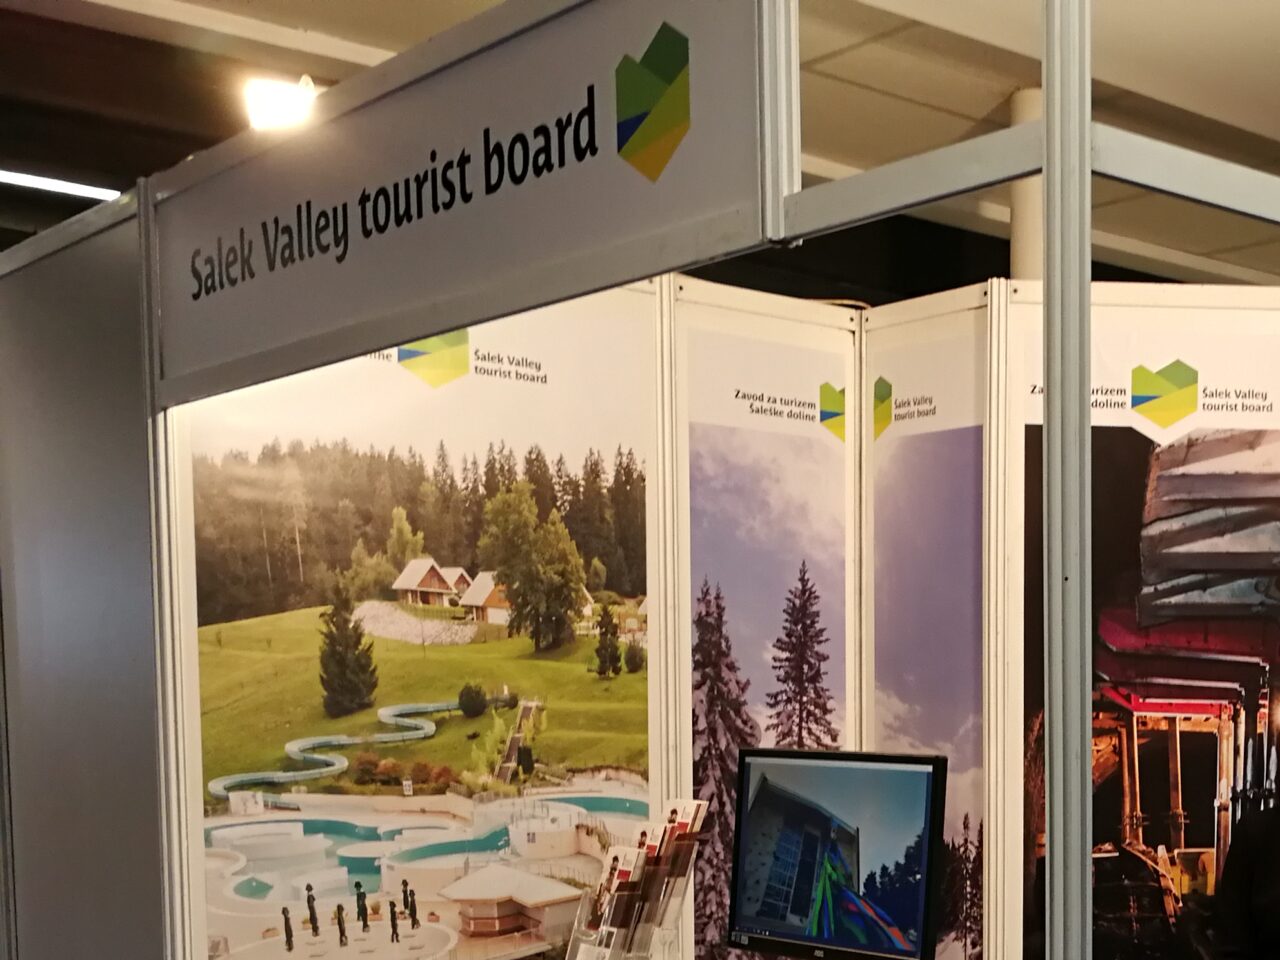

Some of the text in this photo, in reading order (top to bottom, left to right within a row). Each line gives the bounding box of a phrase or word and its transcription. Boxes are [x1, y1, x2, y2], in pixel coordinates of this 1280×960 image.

[191, 84, 599, 301] Salek Valley tourist board
[474, 349, 542, 372] Šalek Valley
[474, 365, 548, 384] tourist board
[734, 388, 817, 410] Zavod za turizem
[912, 395, 933, 408] Valley
[1202, 387, 1268, 402] Šalek Valley
[749, 402, 817, 422] Šaleške doline
[1091, 398, 1127, 409] doline
[1202, 401, 1273, 413] tourist board
[894, 406, 937, 421] tourist board
